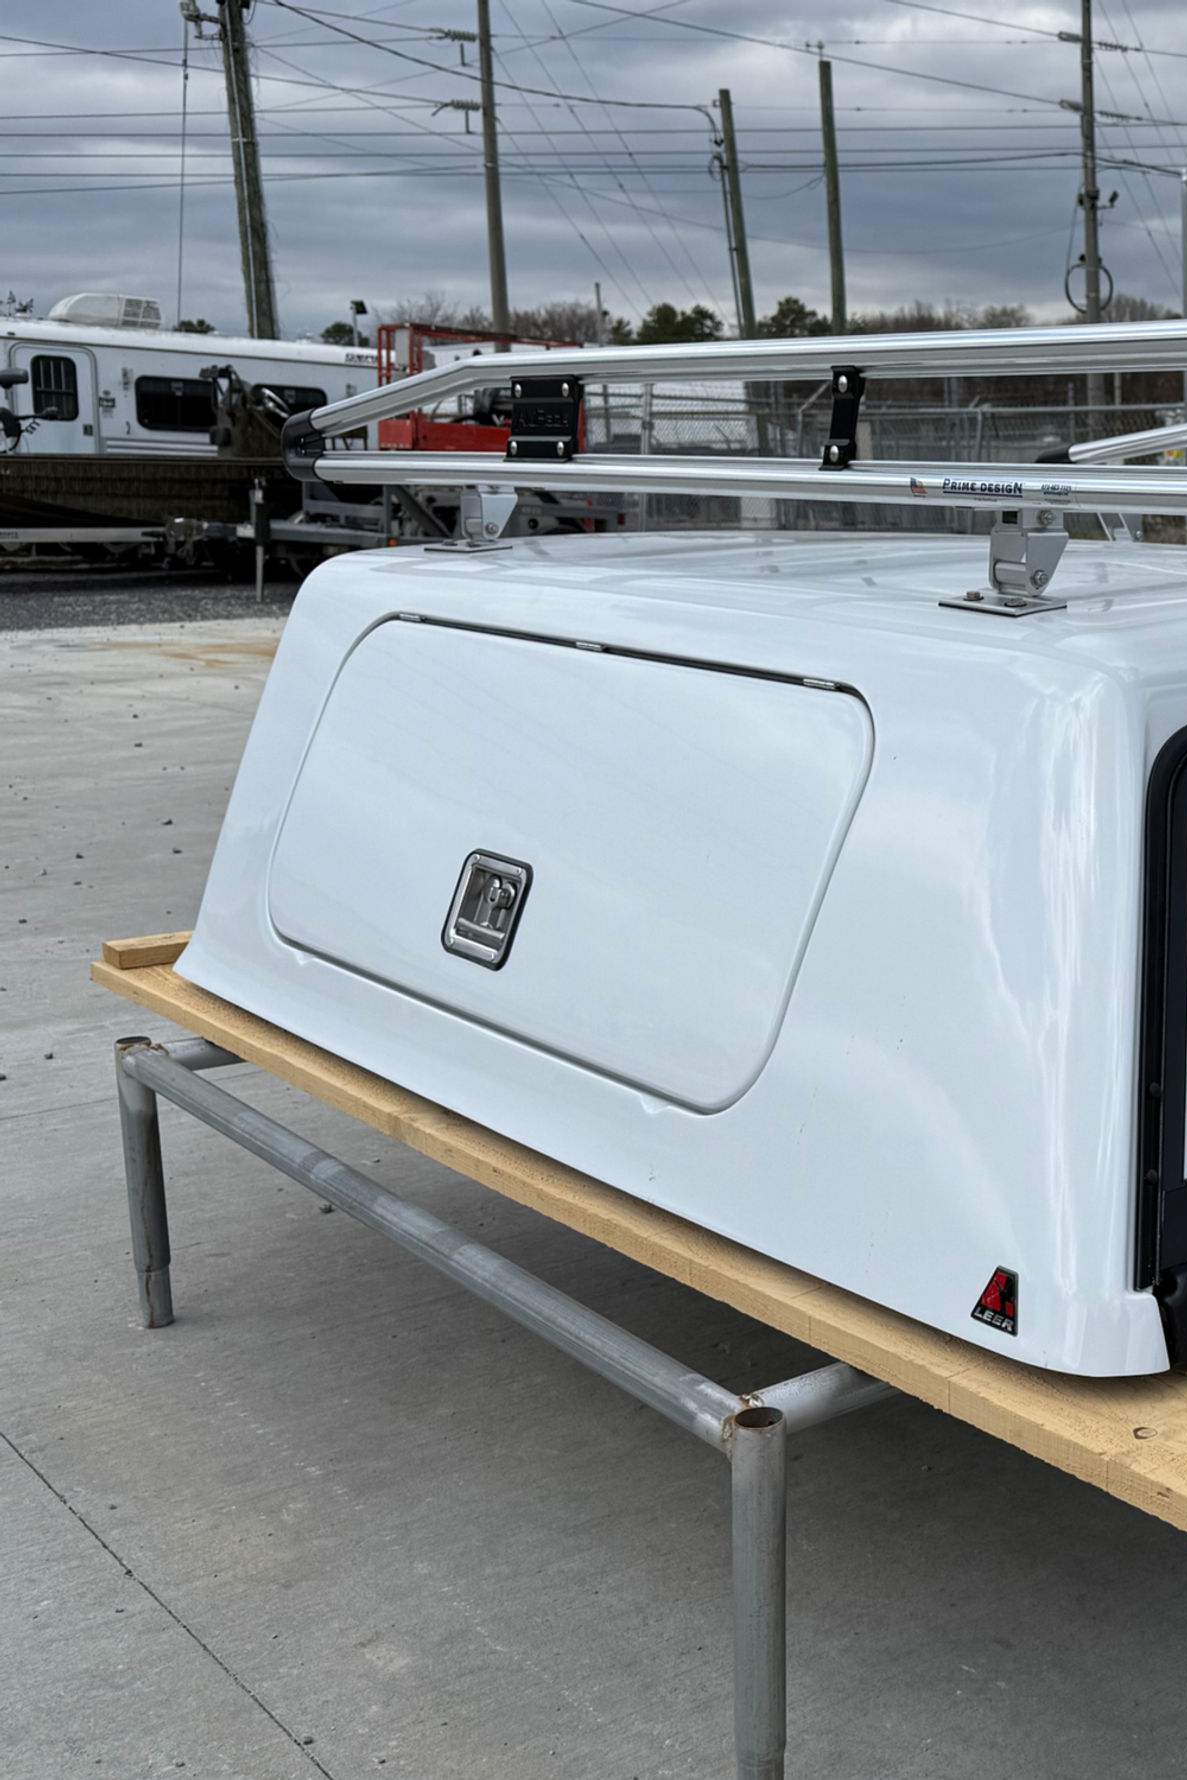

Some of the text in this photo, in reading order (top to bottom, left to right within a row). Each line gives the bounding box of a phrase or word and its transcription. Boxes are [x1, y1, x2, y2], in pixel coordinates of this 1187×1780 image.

[942, 478, 1023, 494] PRIME DESIGN
[974, 1307, 1014, 1331] LEER
